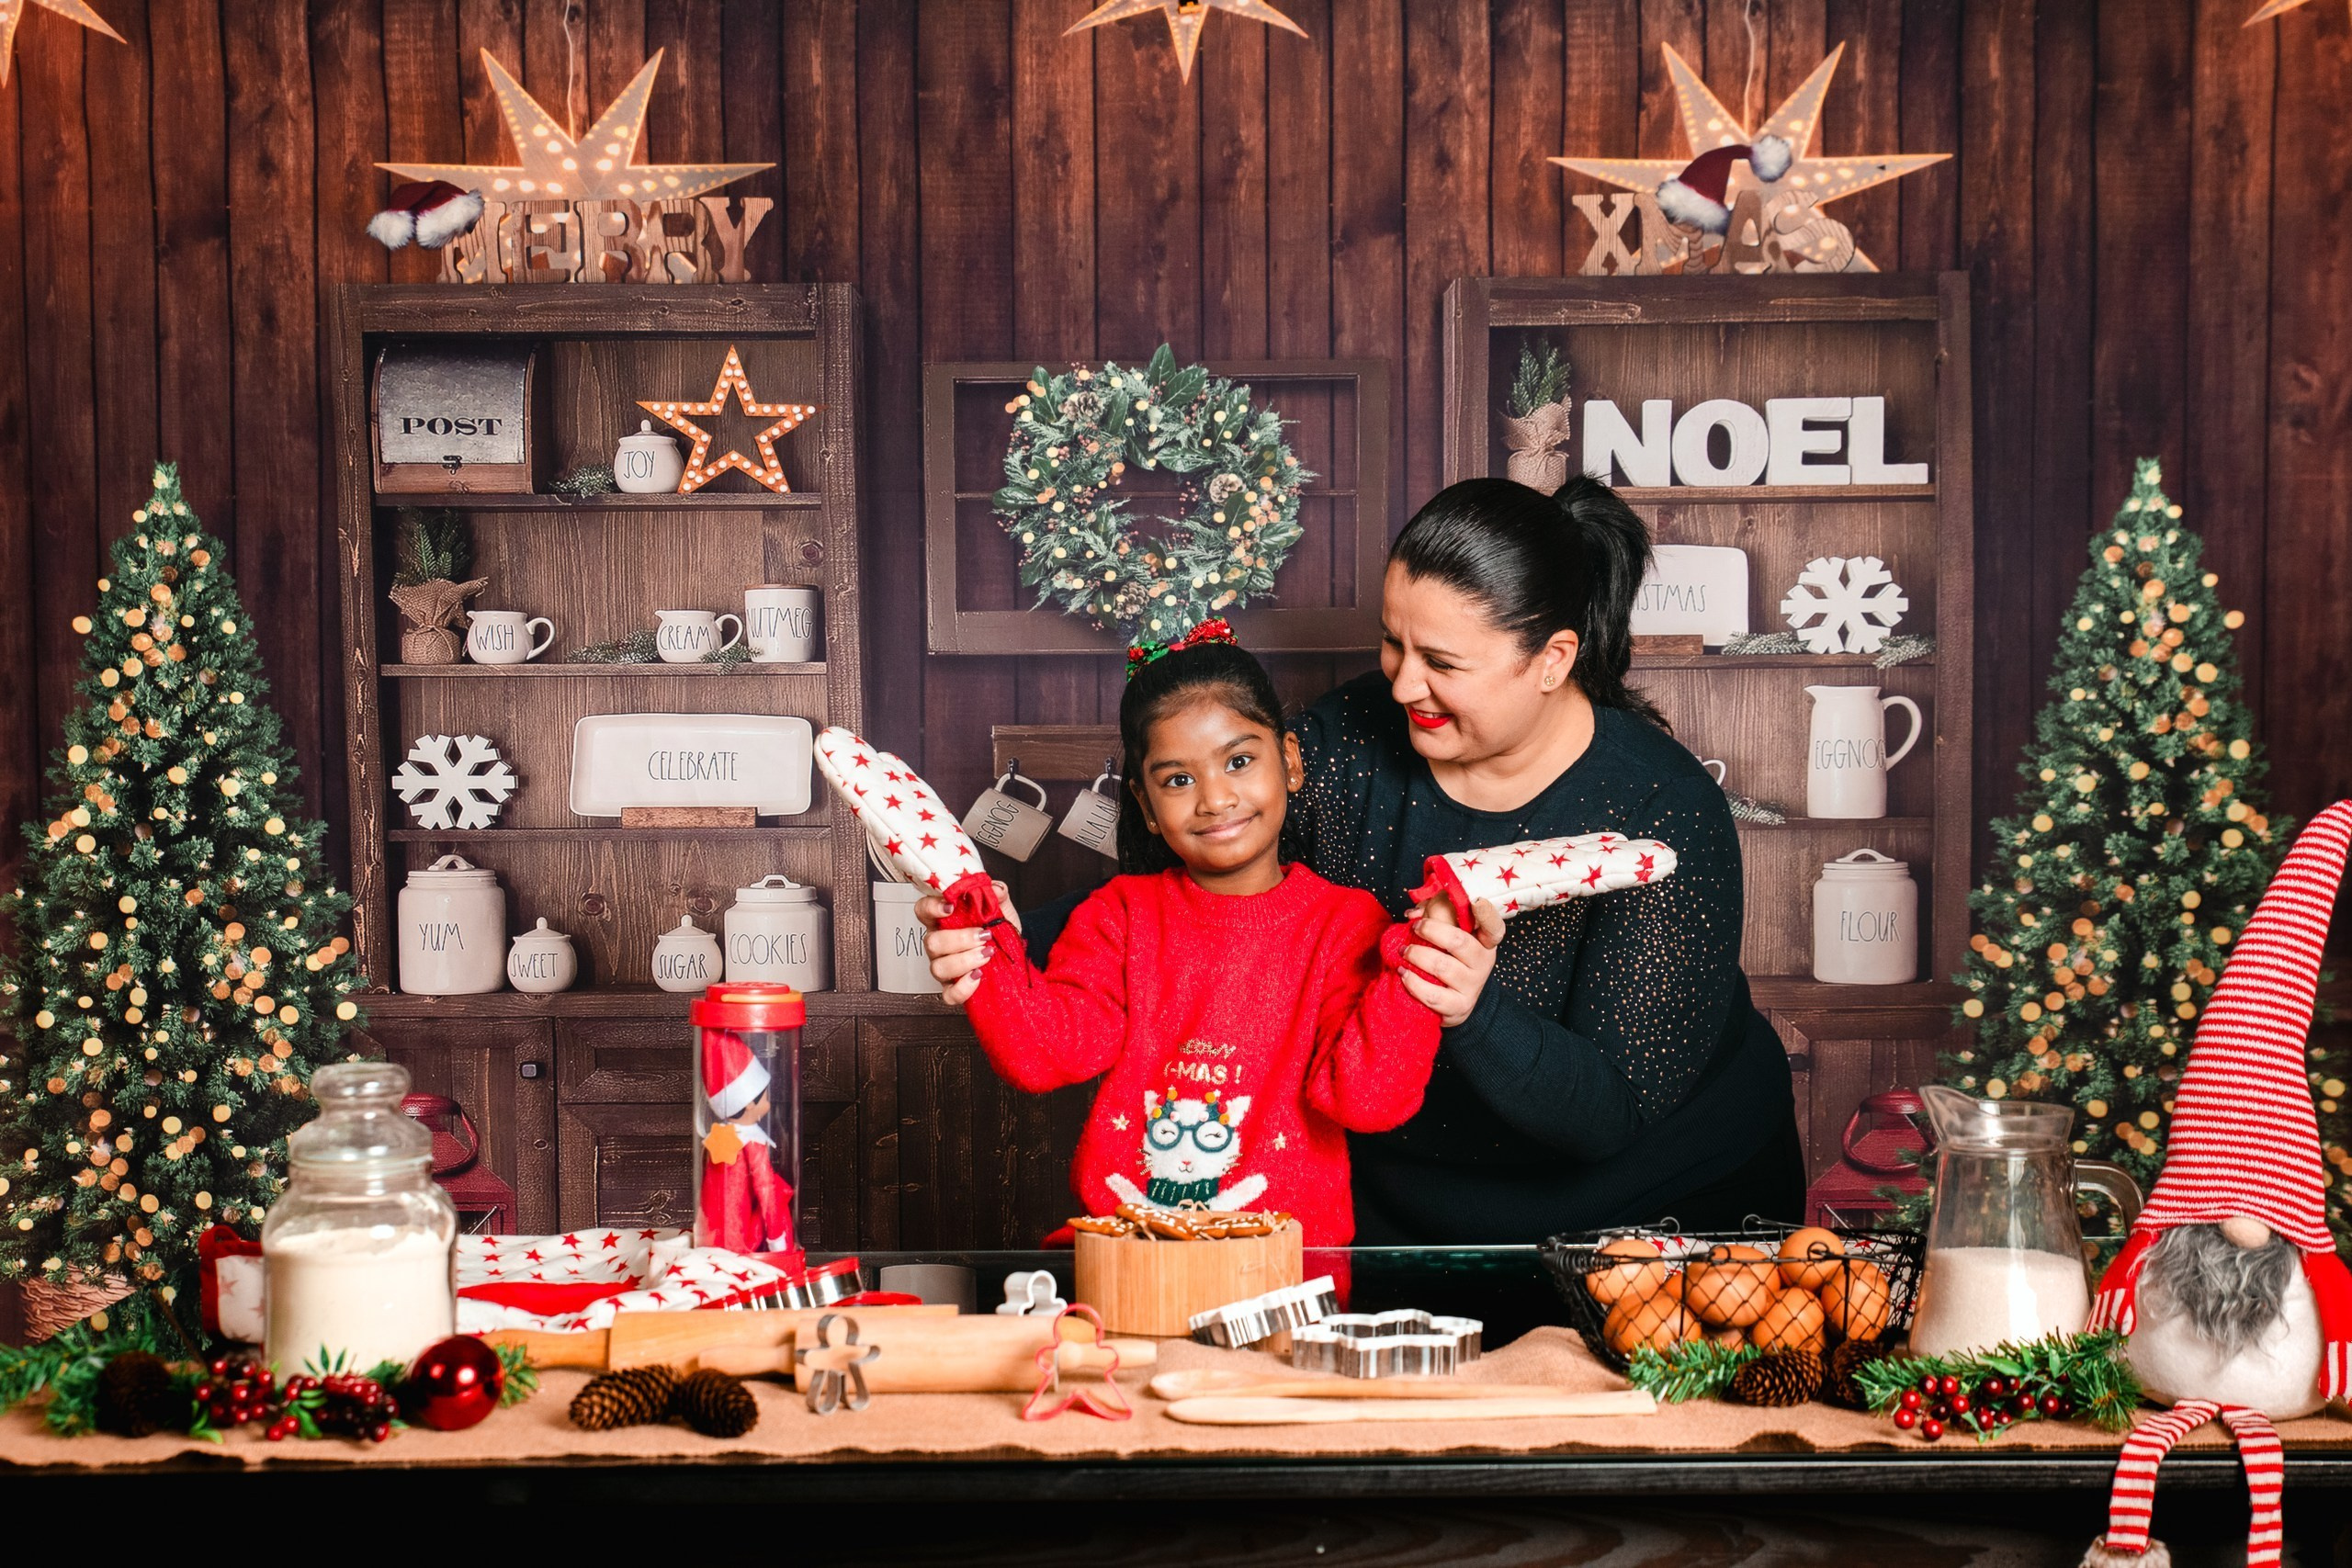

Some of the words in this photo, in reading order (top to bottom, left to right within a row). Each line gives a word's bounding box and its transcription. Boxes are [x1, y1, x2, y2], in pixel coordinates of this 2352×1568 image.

[436, 197, 774, 283] MERRY
[399, 416, 503, 435] POST
[1583, 396, 1928, 486] NOEL
[623, 450, 655, 479] JOY
[1633, 583, 1706, 613] ISTMAS
[475, 625, 514, 651] WISH
[659, 625, 713, 651] CREAM
[648, 750, 739, 781] CELEBRATE
[1815, 739, 1886, 770] EGGNOG
[419, 923, 464, 951] YUM
[1840, 910, 1901, 942] FLOUR
[730, 933, 808, 964] COOKIES
[896, 927, 927, 956] BAK
[511, 953, 559, 978] SWEET
[658, 953, 708, 979] SUGAR
